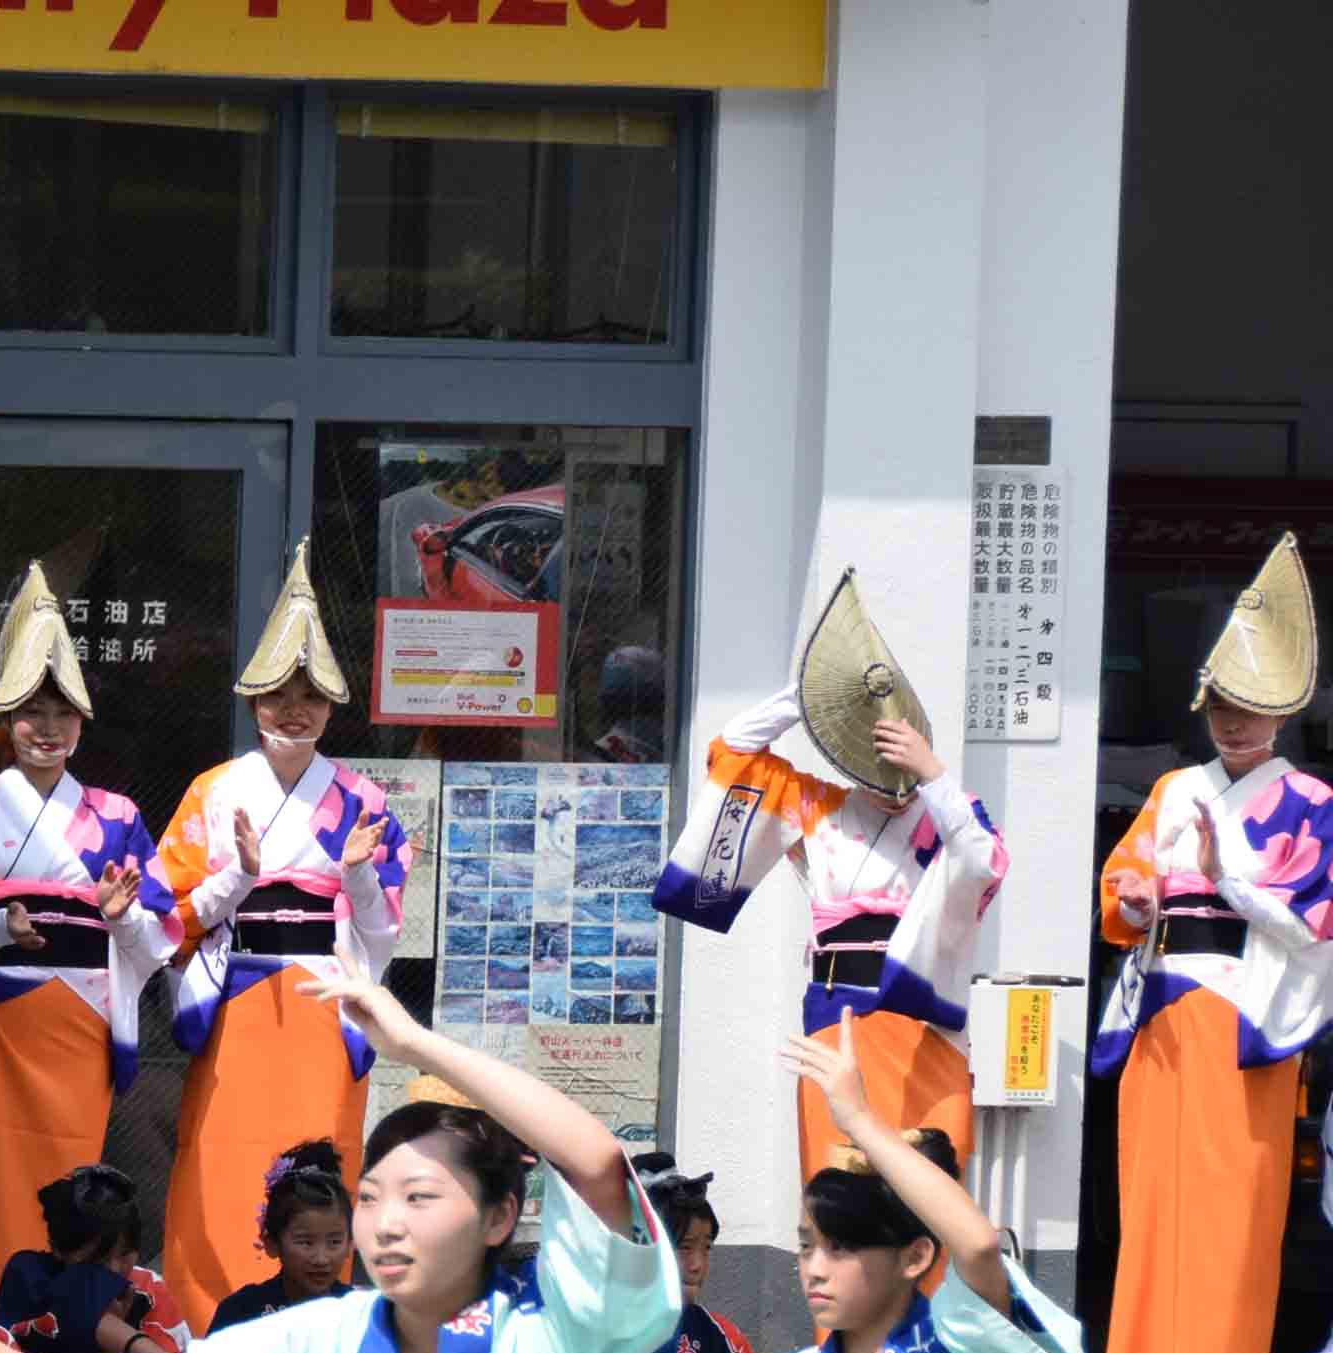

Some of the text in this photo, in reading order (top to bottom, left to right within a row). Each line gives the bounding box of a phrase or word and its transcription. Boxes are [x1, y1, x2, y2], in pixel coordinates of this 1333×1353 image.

[995, 483, 1016, 594] 貯蔵最大数量
[1018, 483, 1038, 594] 危険物の品名
